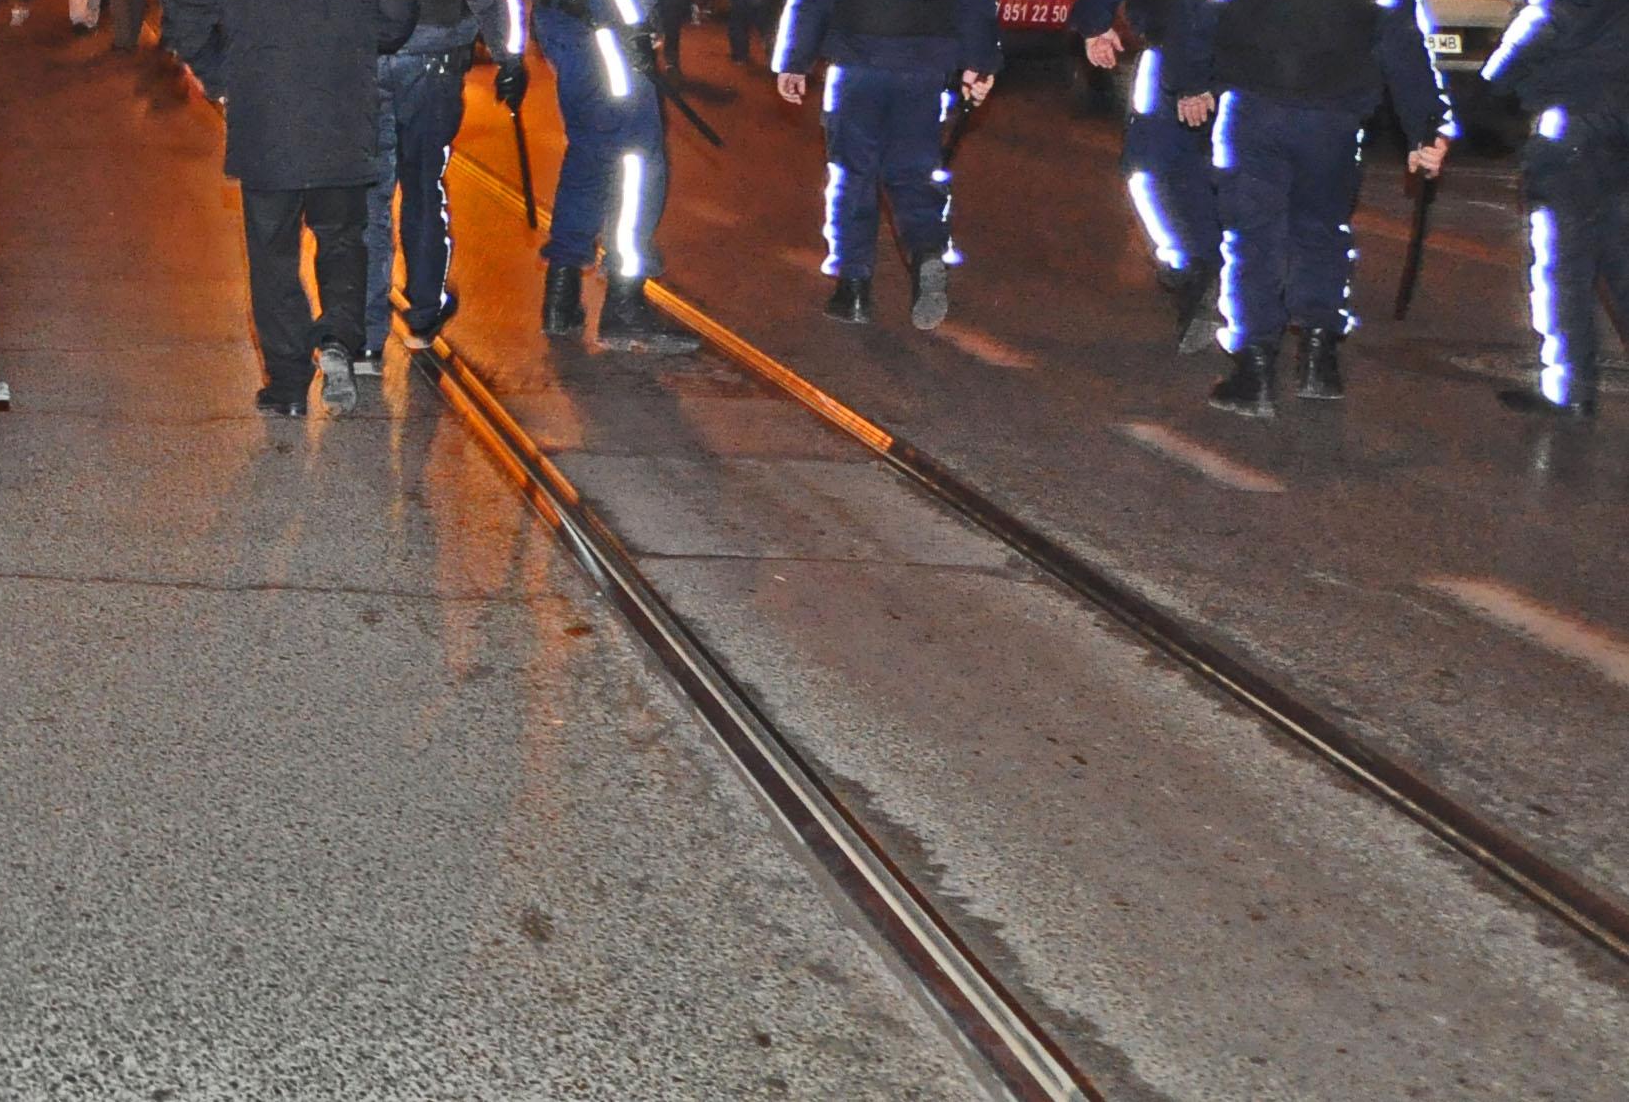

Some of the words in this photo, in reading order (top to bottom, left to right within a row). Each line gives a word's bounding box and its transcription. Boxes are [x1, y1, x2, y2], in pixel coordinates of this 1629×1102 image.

[1003, 3, 1028, 21] 851
[1031, 4, 1048, 22] 22
[1051, 5, 1068, 23] 50
